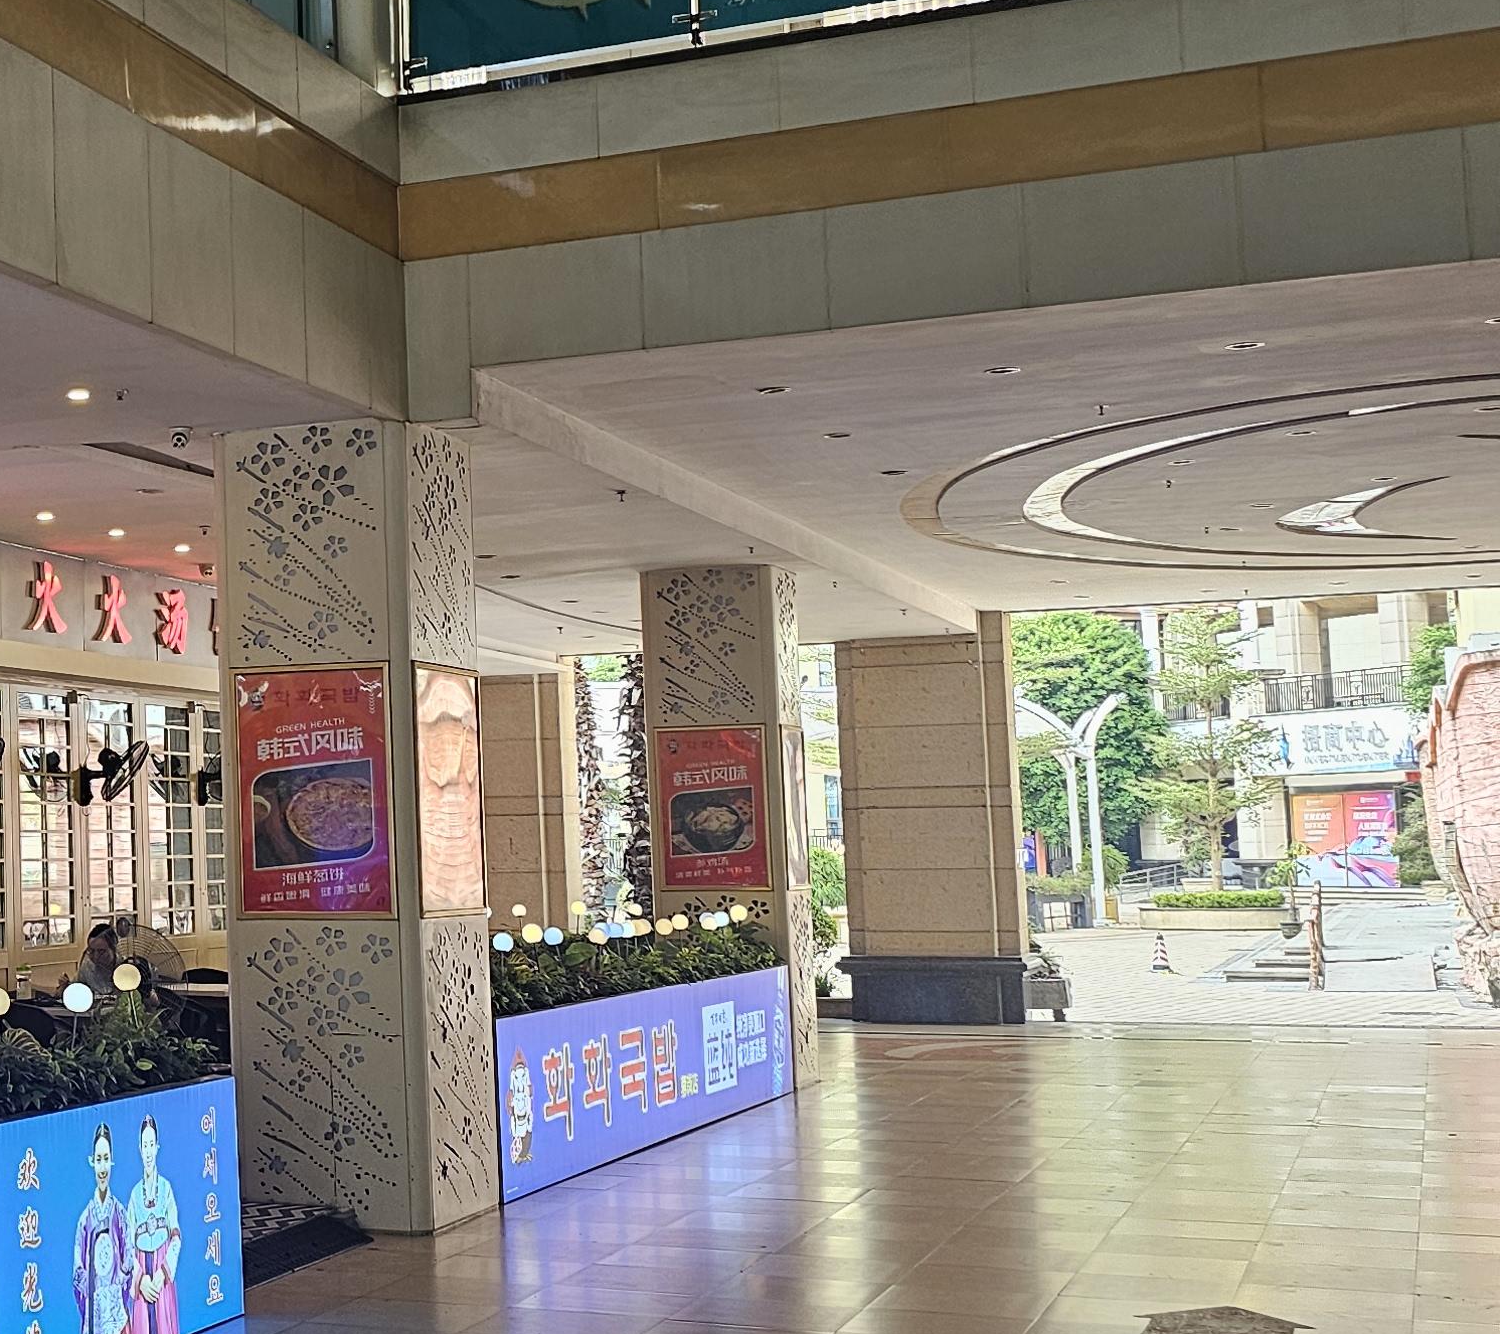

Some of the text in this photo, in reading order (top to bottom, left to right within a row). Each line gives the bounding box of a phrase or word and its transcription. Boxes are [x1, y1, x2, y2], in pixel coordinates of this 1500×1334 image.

[31, 560, 219, 655] 火火汤
[275, 717, 346, 734] GREEN HEALTH
[1302, 721, 1390, 753] 招商中心
[257, 727, 364, 762] 韩式风味
[673, 765, 748, 787] 韩式风味
[542, 1018, 678, 1142] 화화국밥
